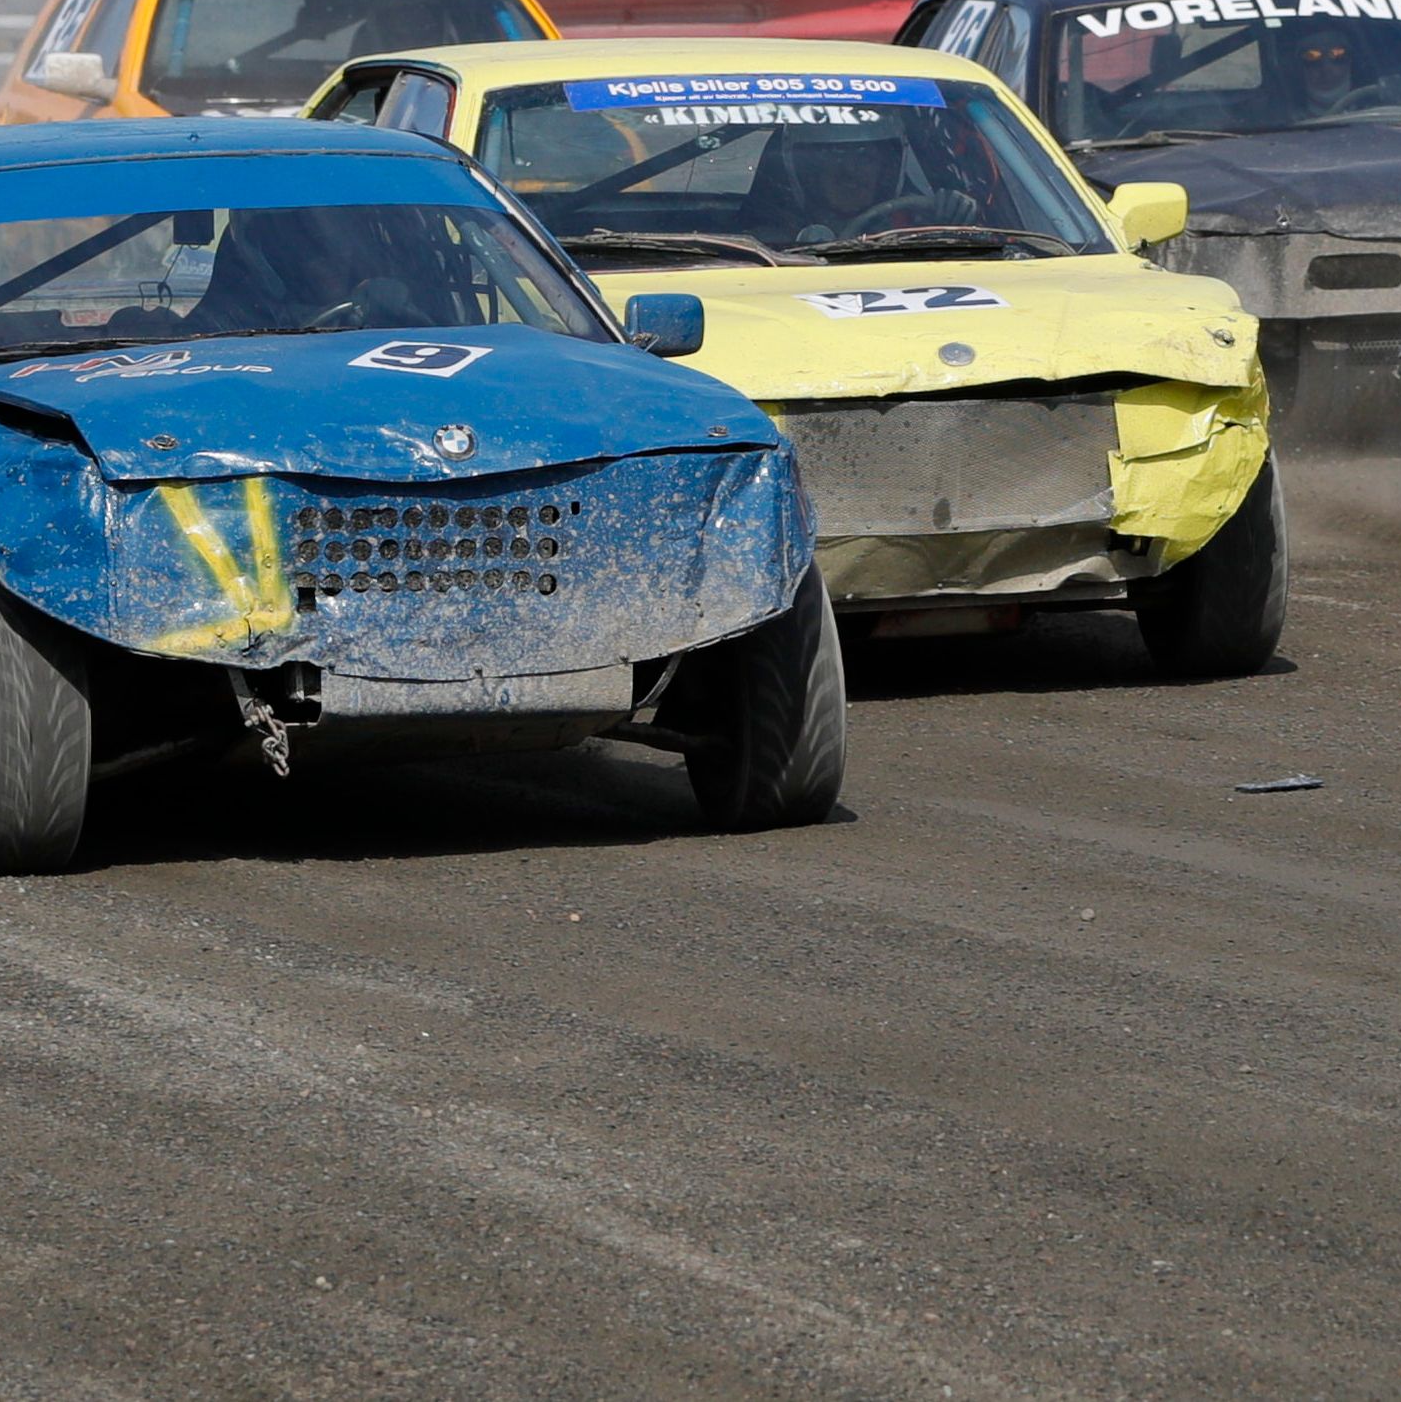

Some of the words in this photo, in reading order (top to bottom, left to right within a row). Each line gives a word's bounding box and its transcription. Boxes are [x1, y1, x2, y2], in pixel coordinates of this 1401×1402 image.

[607, 81, 685, 98] Kjells
[756, 78, 805, 91] 905
[811, 78, 844, 91] 30
[849, 79, 897, 93] 500
[369, 342, 471, 371] 9
